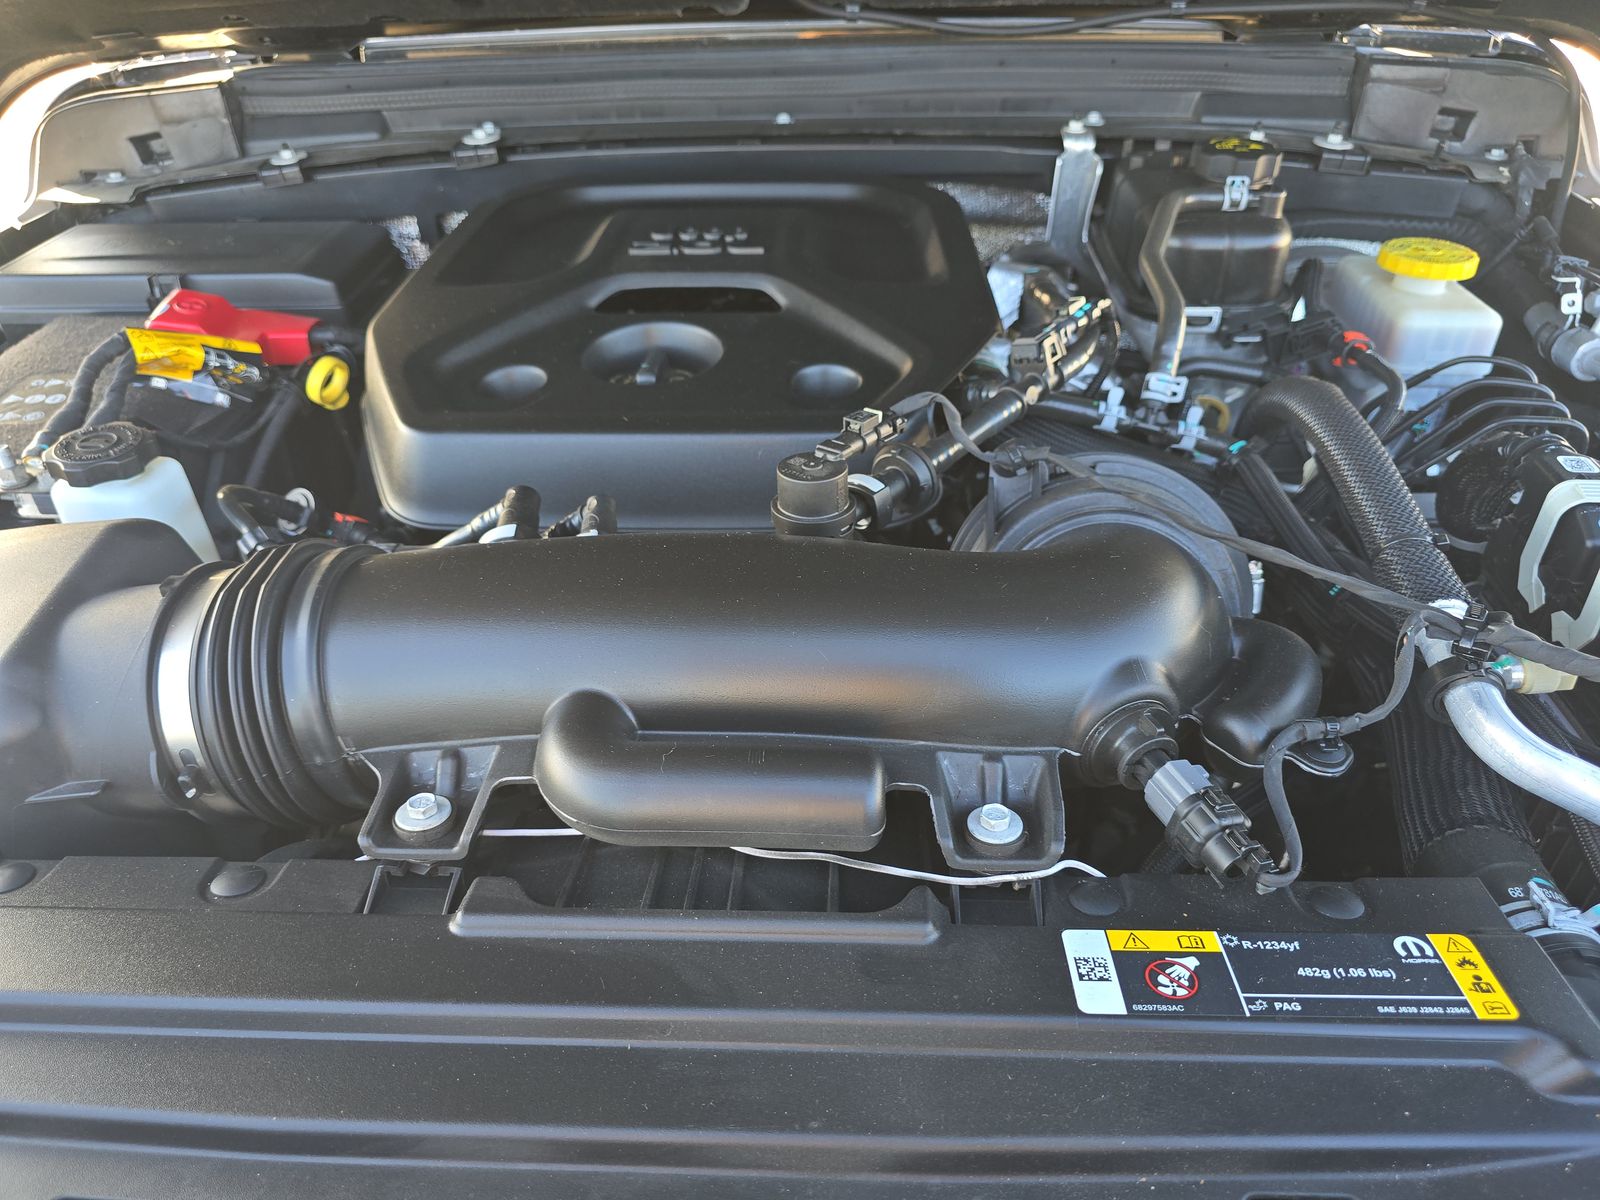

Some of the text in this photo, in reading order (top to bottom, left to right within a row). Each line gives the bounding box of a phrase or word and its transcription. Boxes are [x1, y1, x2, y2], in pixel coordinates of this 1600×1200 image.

[1241, 940, 1300, 952] R-1234yf
[1297, 967, 1397, 980] 482g (1.06 lbs)
[1132, 1004, 1185, 1012] 68297583AC
[1273, 1002, 1302, 1011] PAG
